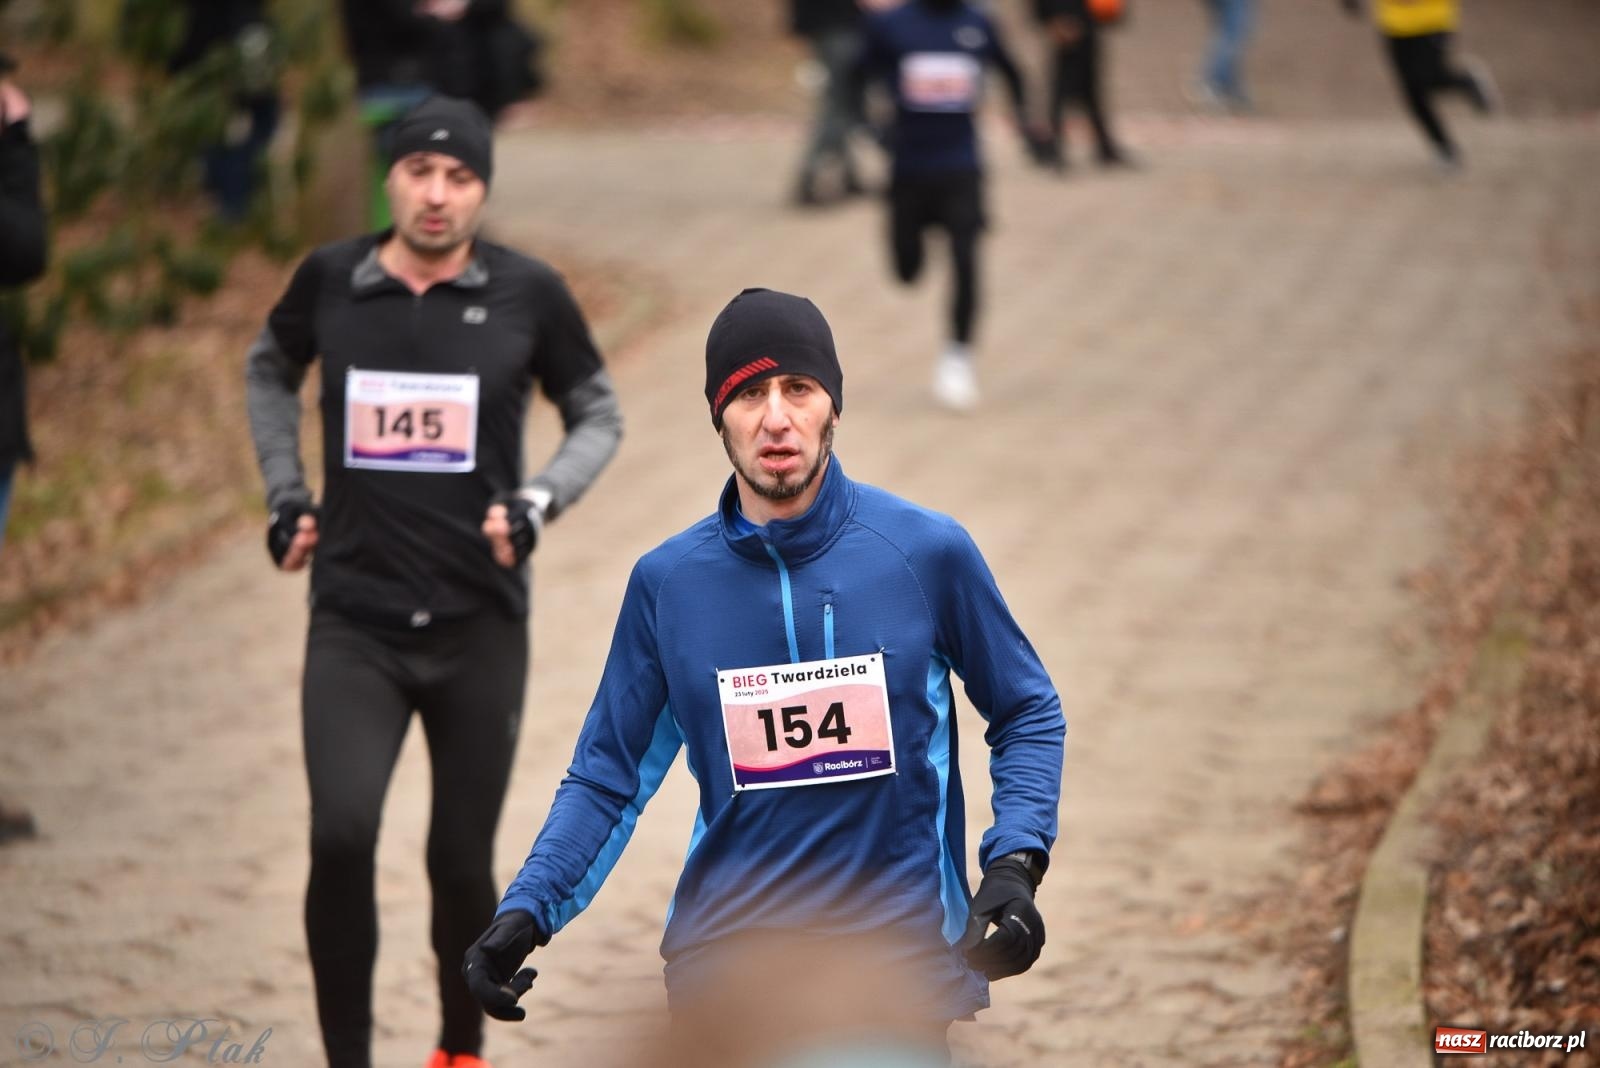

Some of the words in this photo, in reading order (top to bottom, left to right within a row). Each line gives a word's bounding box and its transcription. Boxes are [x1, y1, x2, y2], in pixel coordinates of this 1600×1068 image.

[374, 406, 443, 440] 145
[732, 673, 768, 689] BIEG
[771, 663, 867, 685] Twardziela
[757, 701, 852, 752] 154
[824, 759, 863, 771] Racibórz
